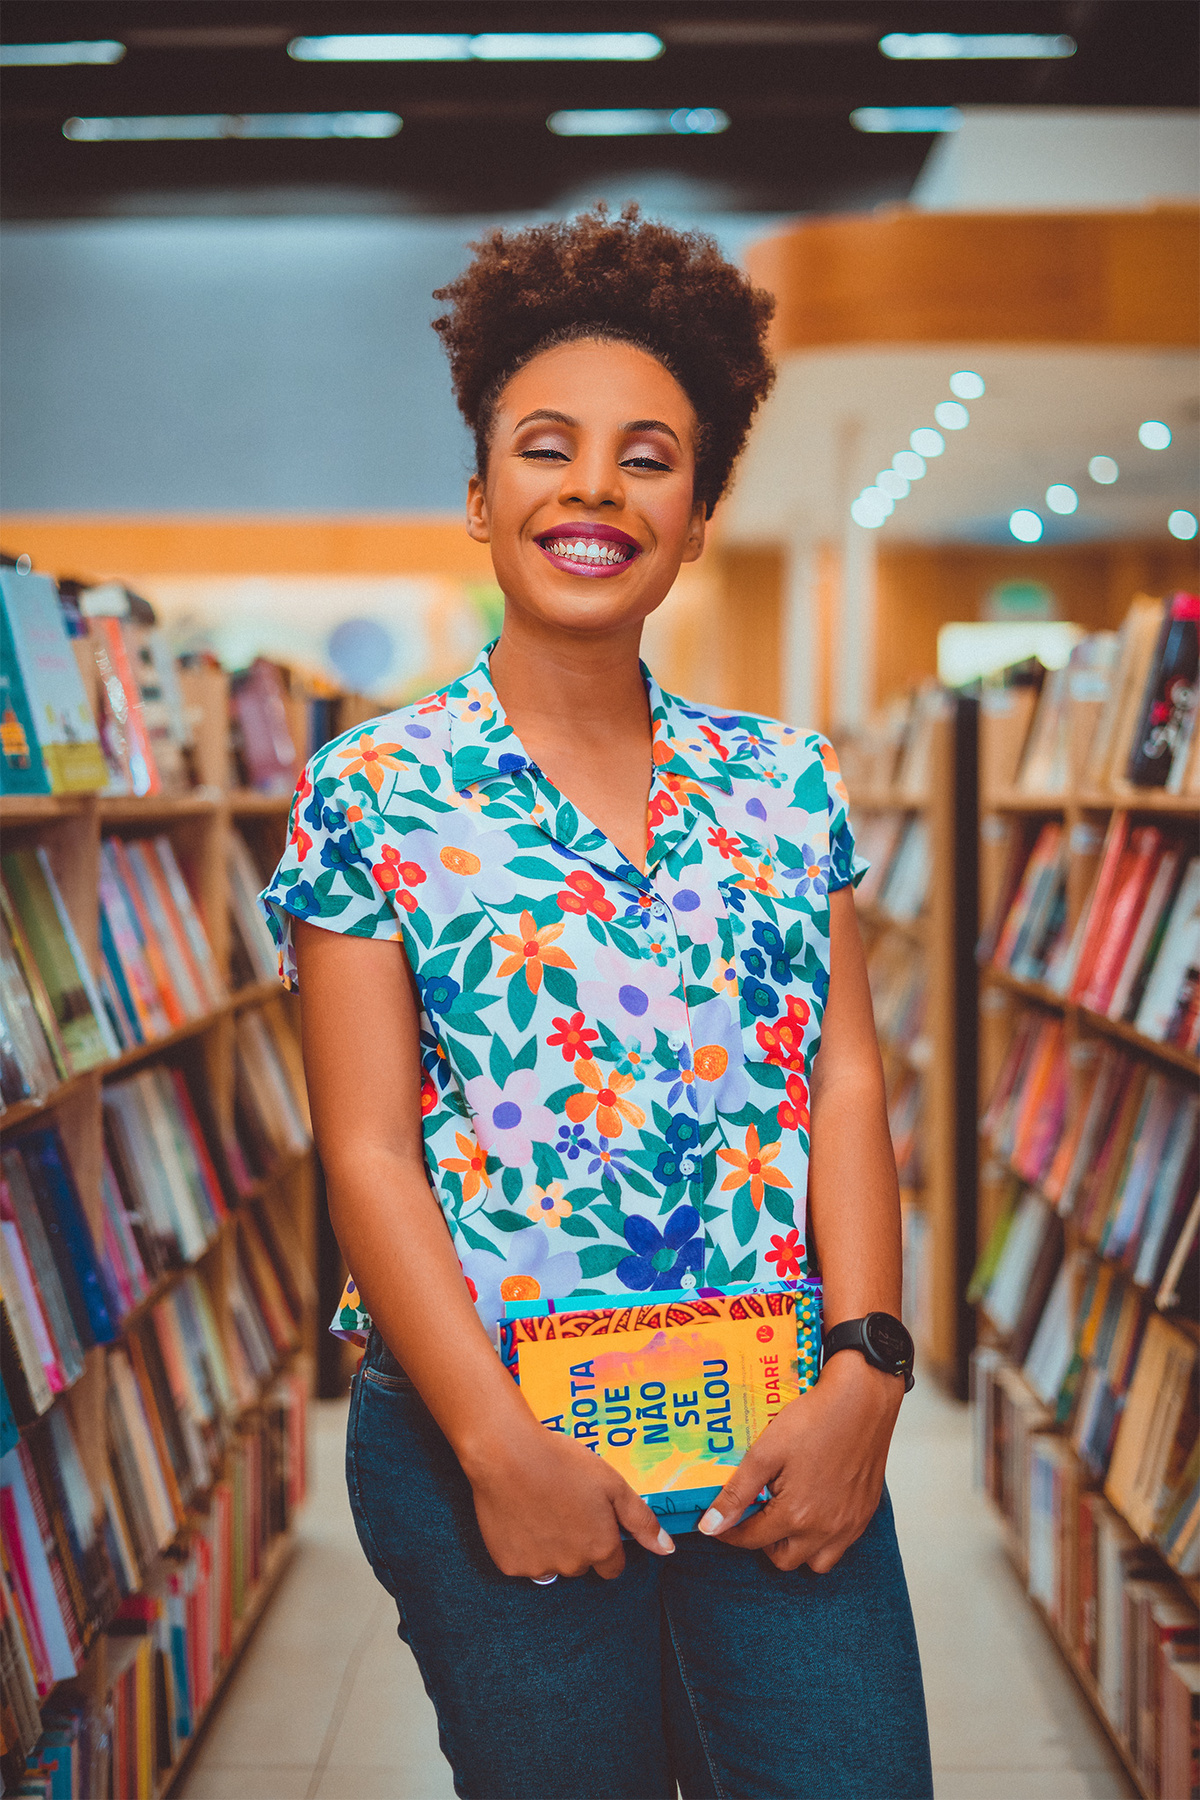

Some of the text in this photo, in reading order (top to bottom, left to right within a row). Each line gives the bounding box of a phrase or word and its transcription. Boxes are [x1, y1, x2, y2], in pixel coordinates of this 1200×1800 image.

[703, 1359, 734, 1453] CALOU
[759, 1354, 781, 1404] DARÉ
[541, 1414, 565, 1433] A
[604, 1386, 637, 1447] QUE
[636, 1382, 669, 1445] NÃO
[673, 1391, 700, 1427] SE
